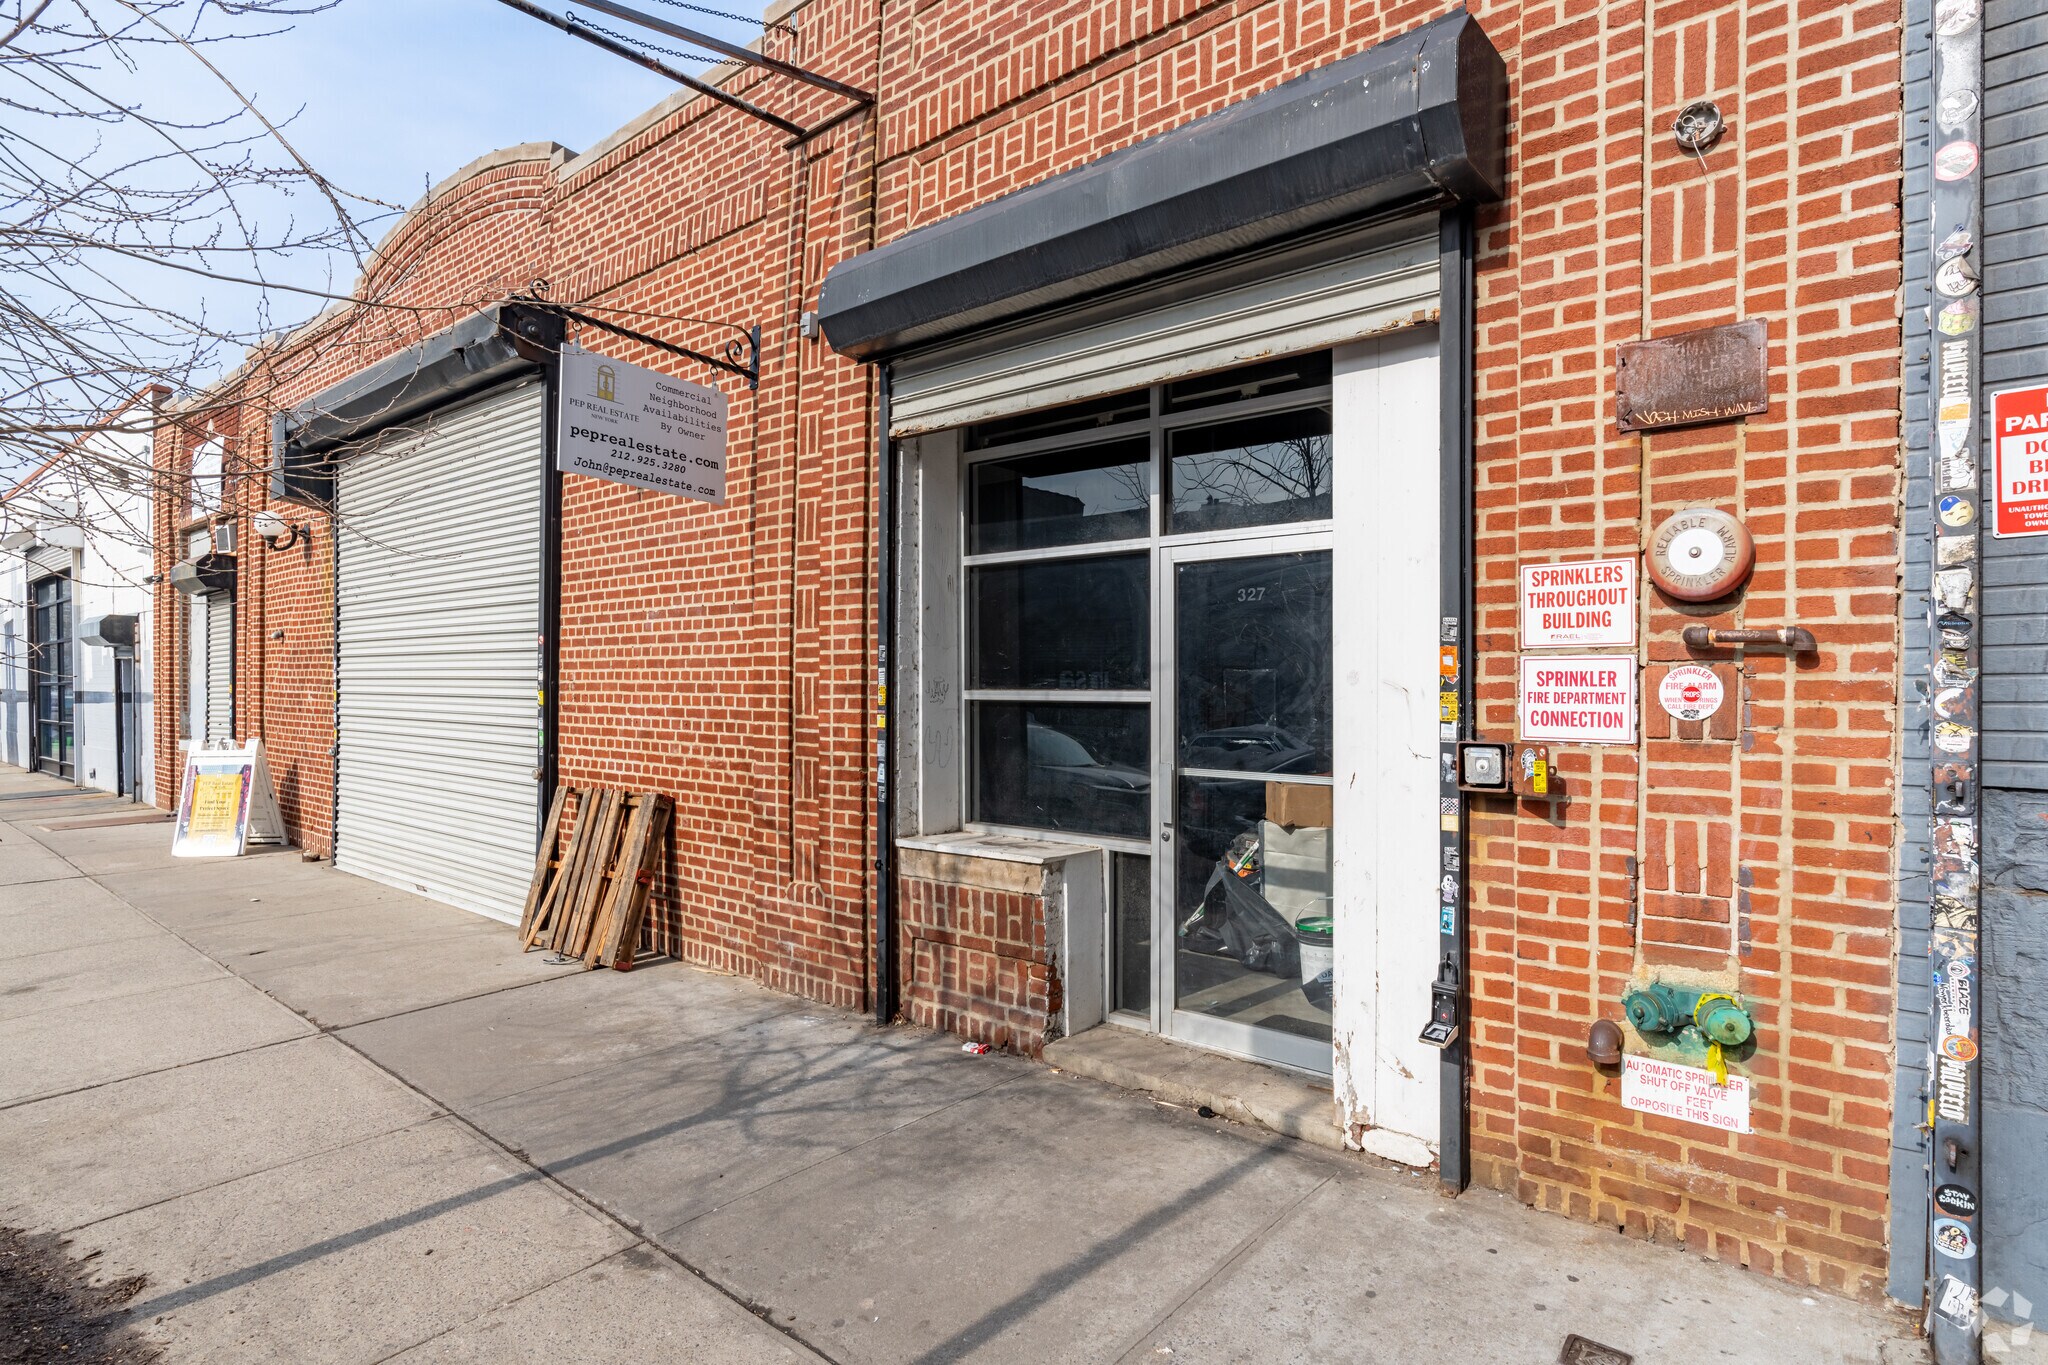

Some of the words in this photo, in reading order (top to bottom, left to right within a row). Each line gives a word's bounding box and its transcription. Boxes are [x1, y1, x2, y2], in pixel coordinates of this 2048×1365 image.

[655, 382, 712, 405] Commercial
[569, 397, 585, 408] PEP
[586, 403, 609, 414] REAL
[609, 408, 640, 422] ESTATE
[591, 413, 603, 421] NEW
[649, 393, 717, 419] Neighborhood
[643, 404, 722, 433] Availabilities
[660, 422, 672, 433] By
[677, 427, 705, 441] Owner
[569, 425, 719, 470] peprealestate.com
[610, 449, 686, 474] 212.925.3280
[574, 456, 716, 496] John@peprealestate.com
[1656, 517, 1707, 557] RELIABLE
[1717, 525, 1737, 563] ALARM
[1531, 565, 1623, 588] SPRINKLERS
[1660, 566, 1726, 588] SPRINKLER
[1237, 587, 1266, 602] 327
[1528, 587, 1628, 609] THROUGHOUT
[1542, 610, 1612, 630] BUILDING
[1536, 670, 1617, 688] SPRINKLER
[1669, 667, 1713, 681] SPRINKLER
[1665, 682, 1684, 690] FIRE
[1527, 691, 1550, 704] FIRE
[1553, 691, 1627, 705] DEPARTMENT
[1530, 710, 1624, 729] CONNECTION
[1640, 1074, 1668, 1088] SHUT
[1670, 1080, 1691, 1093] OFF
[1694, 1085, 1728, 1101] VALVE
[1630, 1096, 1683, 1116] OPPOSITE
[1685, 1107, 1709, 1122] THIS
[1712, 1114, 1739, 1129] SIGN
[1686, 1096, 1714, 1110] FEET
[1938, 1194, 1975, 1210] COOKIN
[1944, 1188, 1970, 1201] STAY
